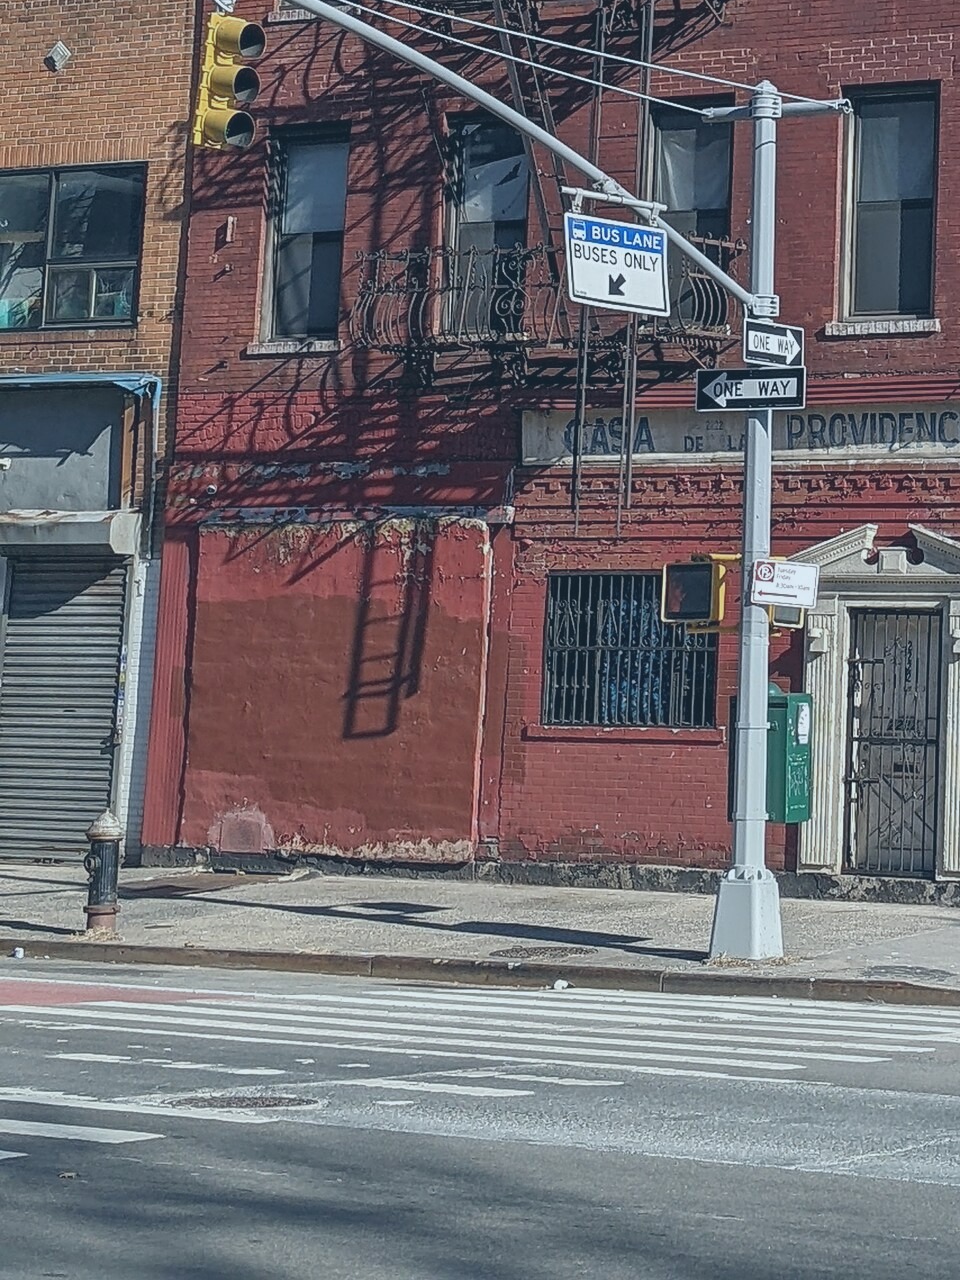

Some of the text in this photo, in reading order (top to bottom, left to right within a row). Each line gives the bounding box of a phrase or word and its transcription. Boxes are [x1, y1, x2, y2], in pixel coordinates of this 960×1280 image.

[591, 225, 662, 250] BUS LANE
[573, 243, 659, 272] BUSES ONLY
[753, 334, 795, 355] ONE WAY
[713, 379, 791, 398] ONE WAY
[563, 416, 655, 455] CASA
[684, 435, 703, 452] DE
